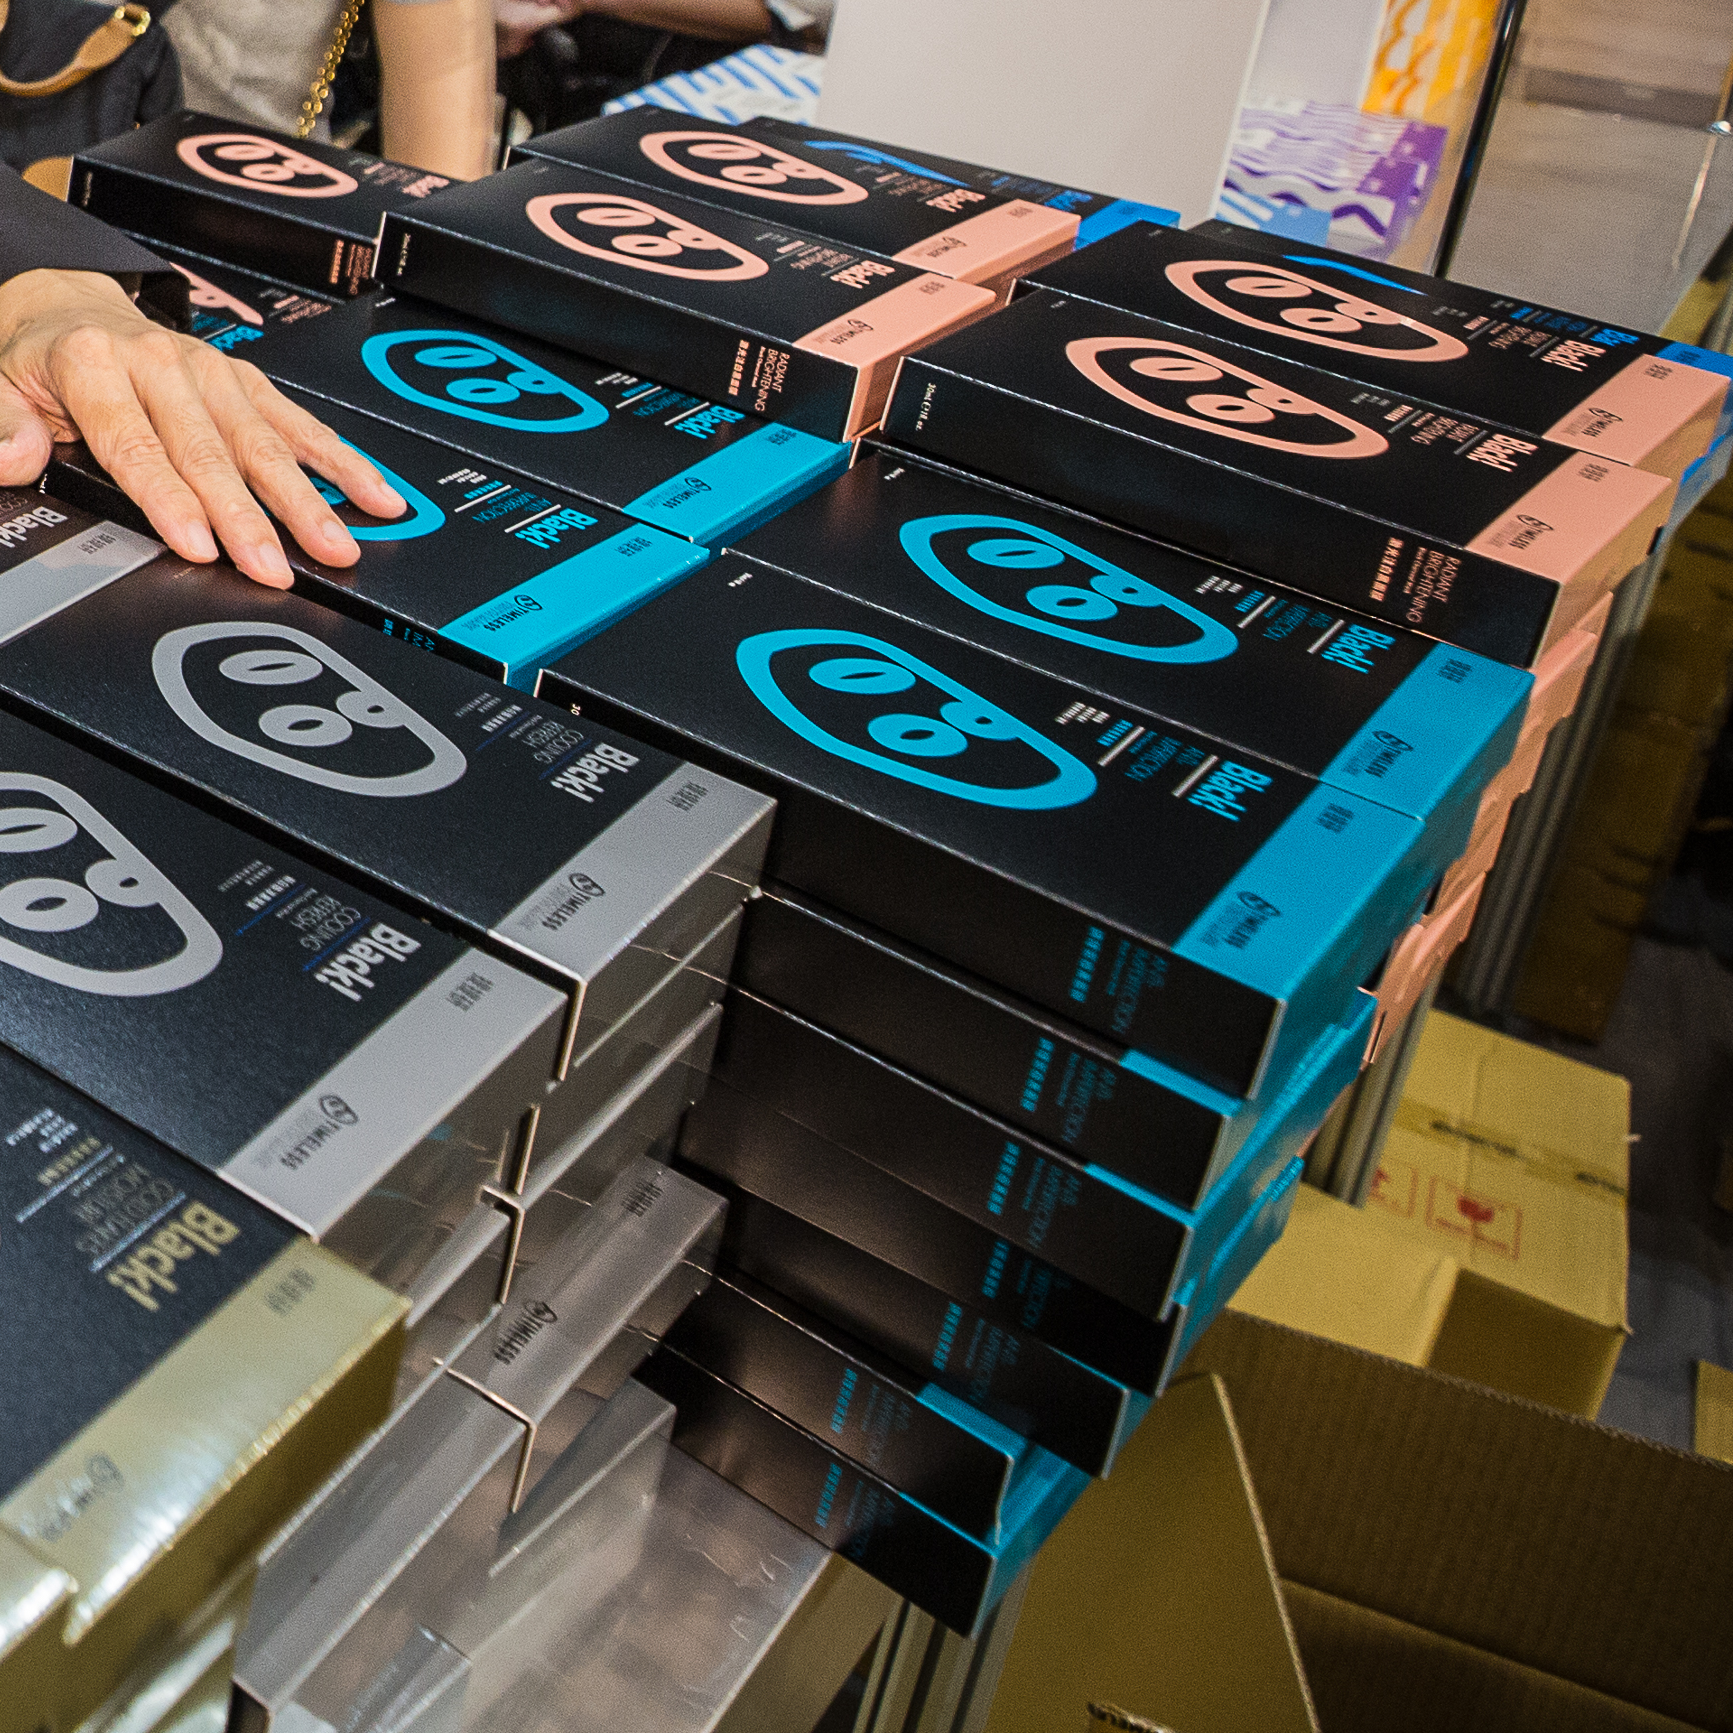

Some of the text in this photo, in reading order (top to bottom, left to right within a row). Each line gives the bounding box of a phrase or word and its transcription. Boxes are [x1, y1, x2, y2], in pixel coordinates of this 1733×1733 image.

[830, 259, 896, 289] Black!
[771, 351, 791, 394] RADIANT
[1540, 338, 1607, 373] Black!
[754, 348, 779, 412] BRIGHTENING
[674, 404, 746, 440] Black!
[1465, 432, 1539, 473] Black!
[514, 507, 599, 550] Black!
[1405, 549, 1445, 624] BRIGHTENING
[1431, 554, 1463, 604] RADIANT
[483, 606, 531, 633] TIMELESS
[1320, 622, 1397, 675] Black!
[533, 727, 586, 766] COOLING
[549, 741, 642, 804] Black!
[1185, 759, 1274, 823] Black!
[299, 904, 363, 952] COOLING
[541, 891, 593, 932] TIMELESS
[314, 920, 423, 1003] Black!
[279, 1119, 343, 1171] TIMELESS
[103, 1199, 242, 1312] Black!
